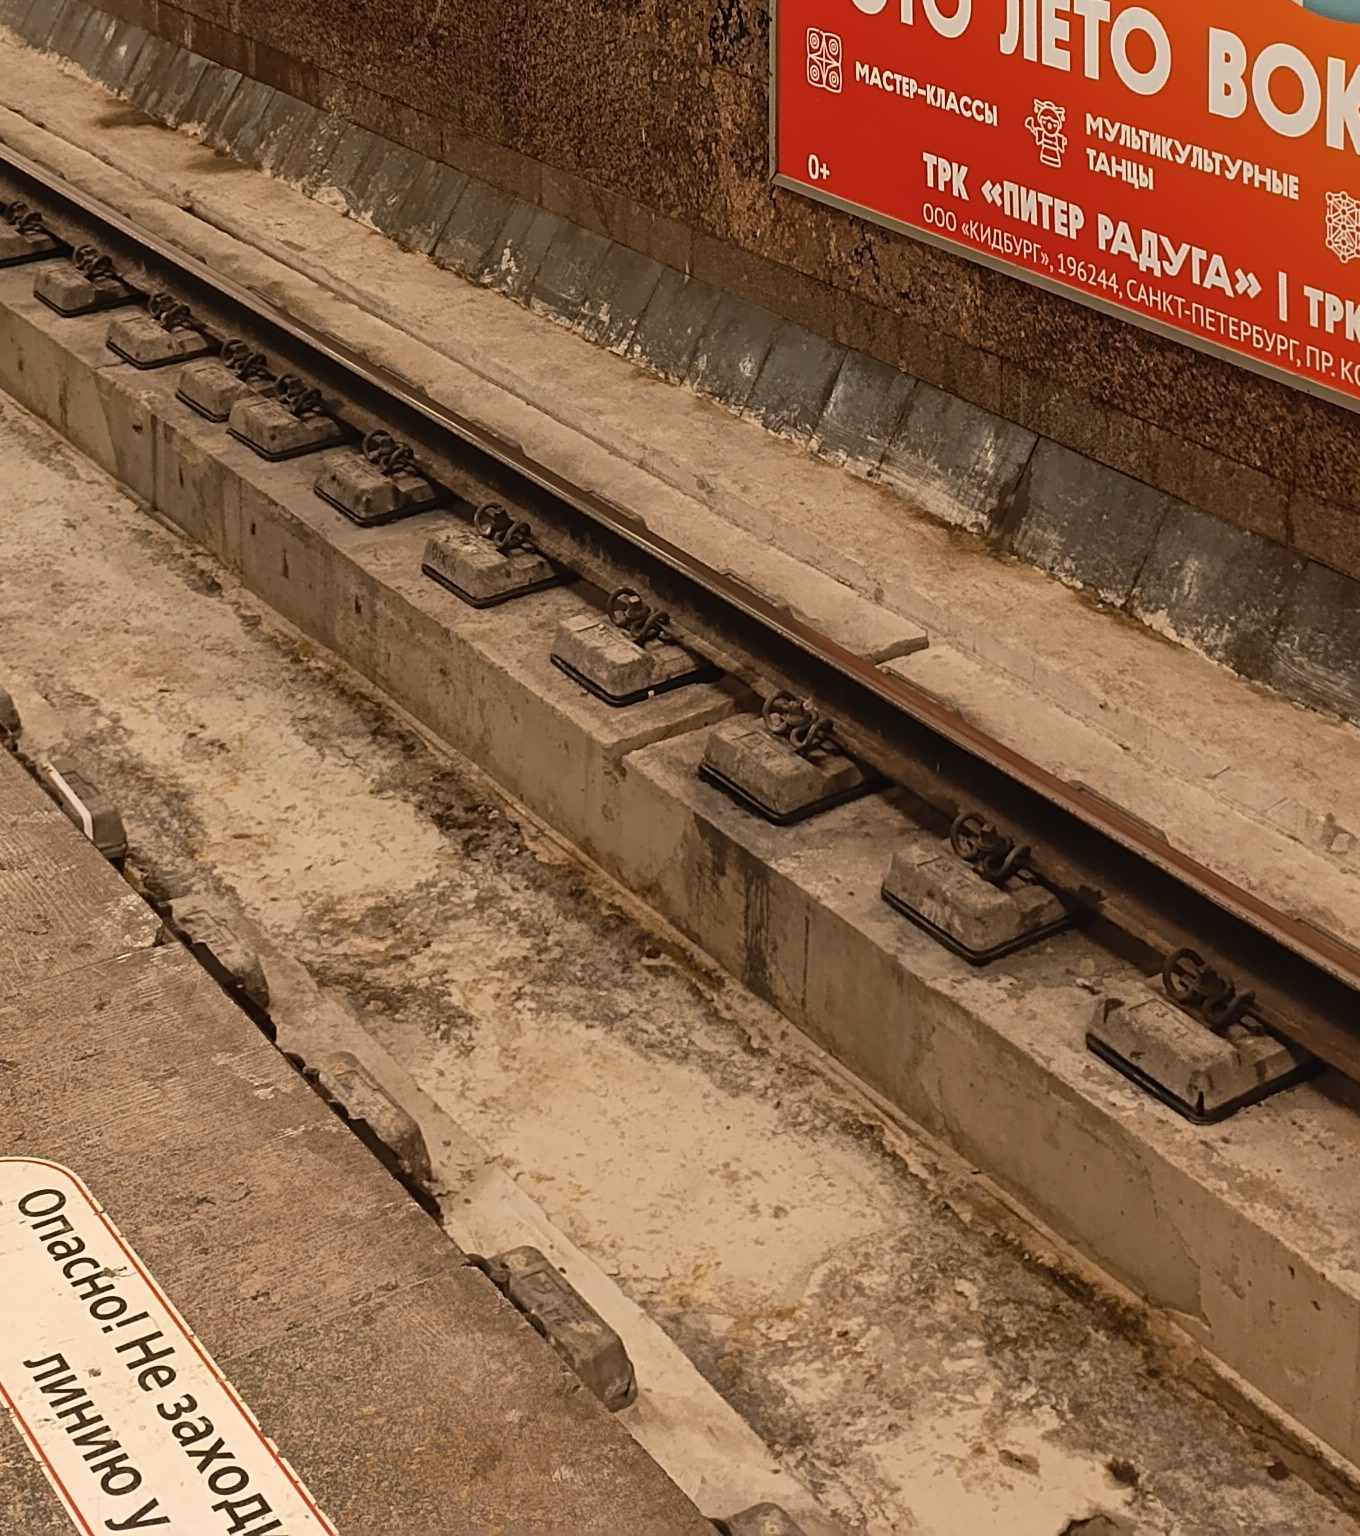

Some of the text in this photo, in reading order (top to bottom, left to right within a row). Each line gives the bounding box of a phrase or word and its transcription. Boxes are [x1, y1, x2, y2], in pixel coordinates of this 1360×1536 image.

[855, 61, 998, 127] МАСТЕР-КЛАССЫ
[806, 153, 831, 182] 0+
[1085, 112, 1300, 201] МУЛЬТИКУЛЬТУРНЫЕ
[1085, 148, 1154, 191] ТАНЦЫ
[922, 151, 970, 202] ТРК
[981, 178, 1086, 240] «ПИТЕР
[1097, 212, 1262, 299] РАДУГА»
[922, 202, 957, 233] ООО
[1057, 252, 1124, 300] 196244,
[1126, 278, 1302, 369] САНКТ-ПЕТЕРБУРГ,
[1305, 342, 1336, 379] ПР.
[16, 1186, 150, 1335] Опасно!
[115, 1330, 178, 1393] Не
[23, 1352, 172, 1534] линию у
